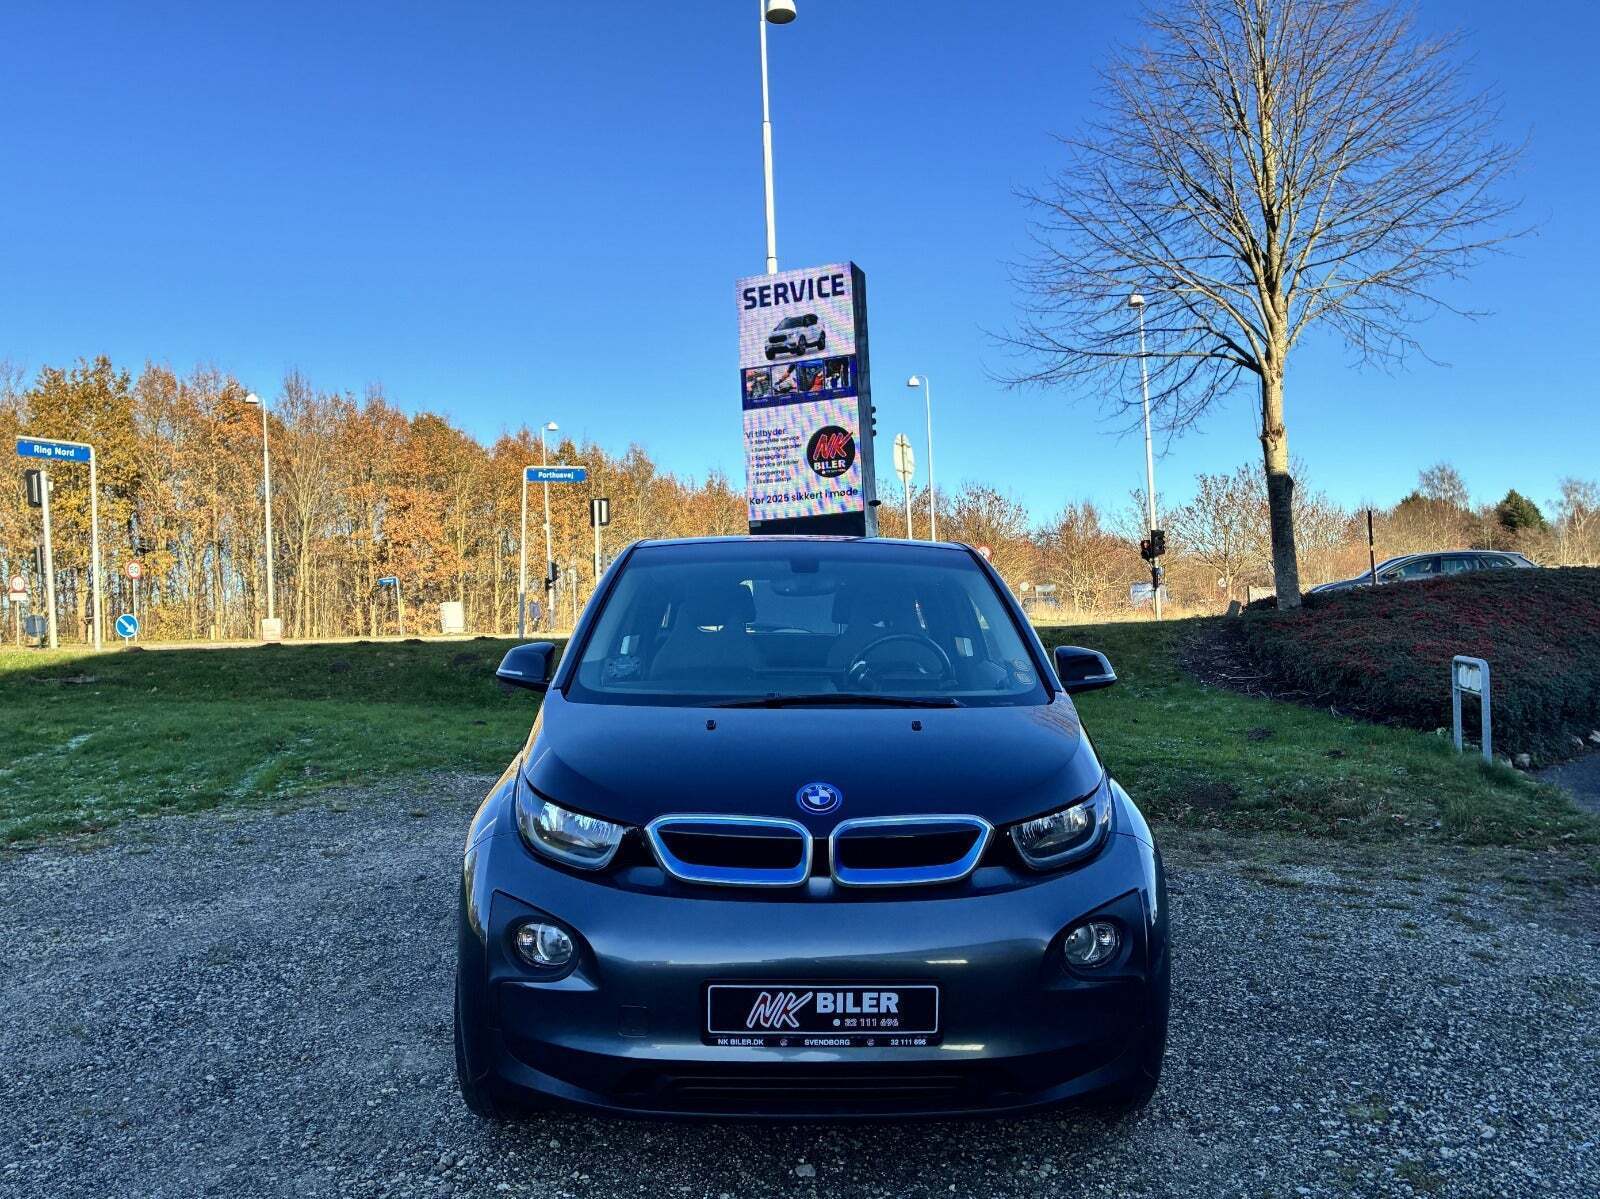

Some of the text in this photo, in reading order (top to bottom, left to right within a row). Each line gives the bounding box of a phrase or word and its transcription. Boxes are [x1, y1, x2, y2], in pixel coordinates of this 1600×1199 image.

[743, 273, 845, 310] SERVICE
[745, 431, 754, 439] Vi
[33, 444, 75, 457] Ring Nord
[813, 432, 853, 460] NK
[813, 460, 846, 471] BILER
[766, 493, 790, 504] 2025
[791, 489, 823, 502] sikkert
[829, 486, 859, 497] møde
[745, 991, 899, 1028] NK BILER
[860, 1018, 877, 1027] 111
[717, 1038, 729, 1046] NK
[730, 1038, 764, 1046] BILER.DK
[890, 1038, 899, 1046] 32
[900, 1038, 912, 1046] 111
